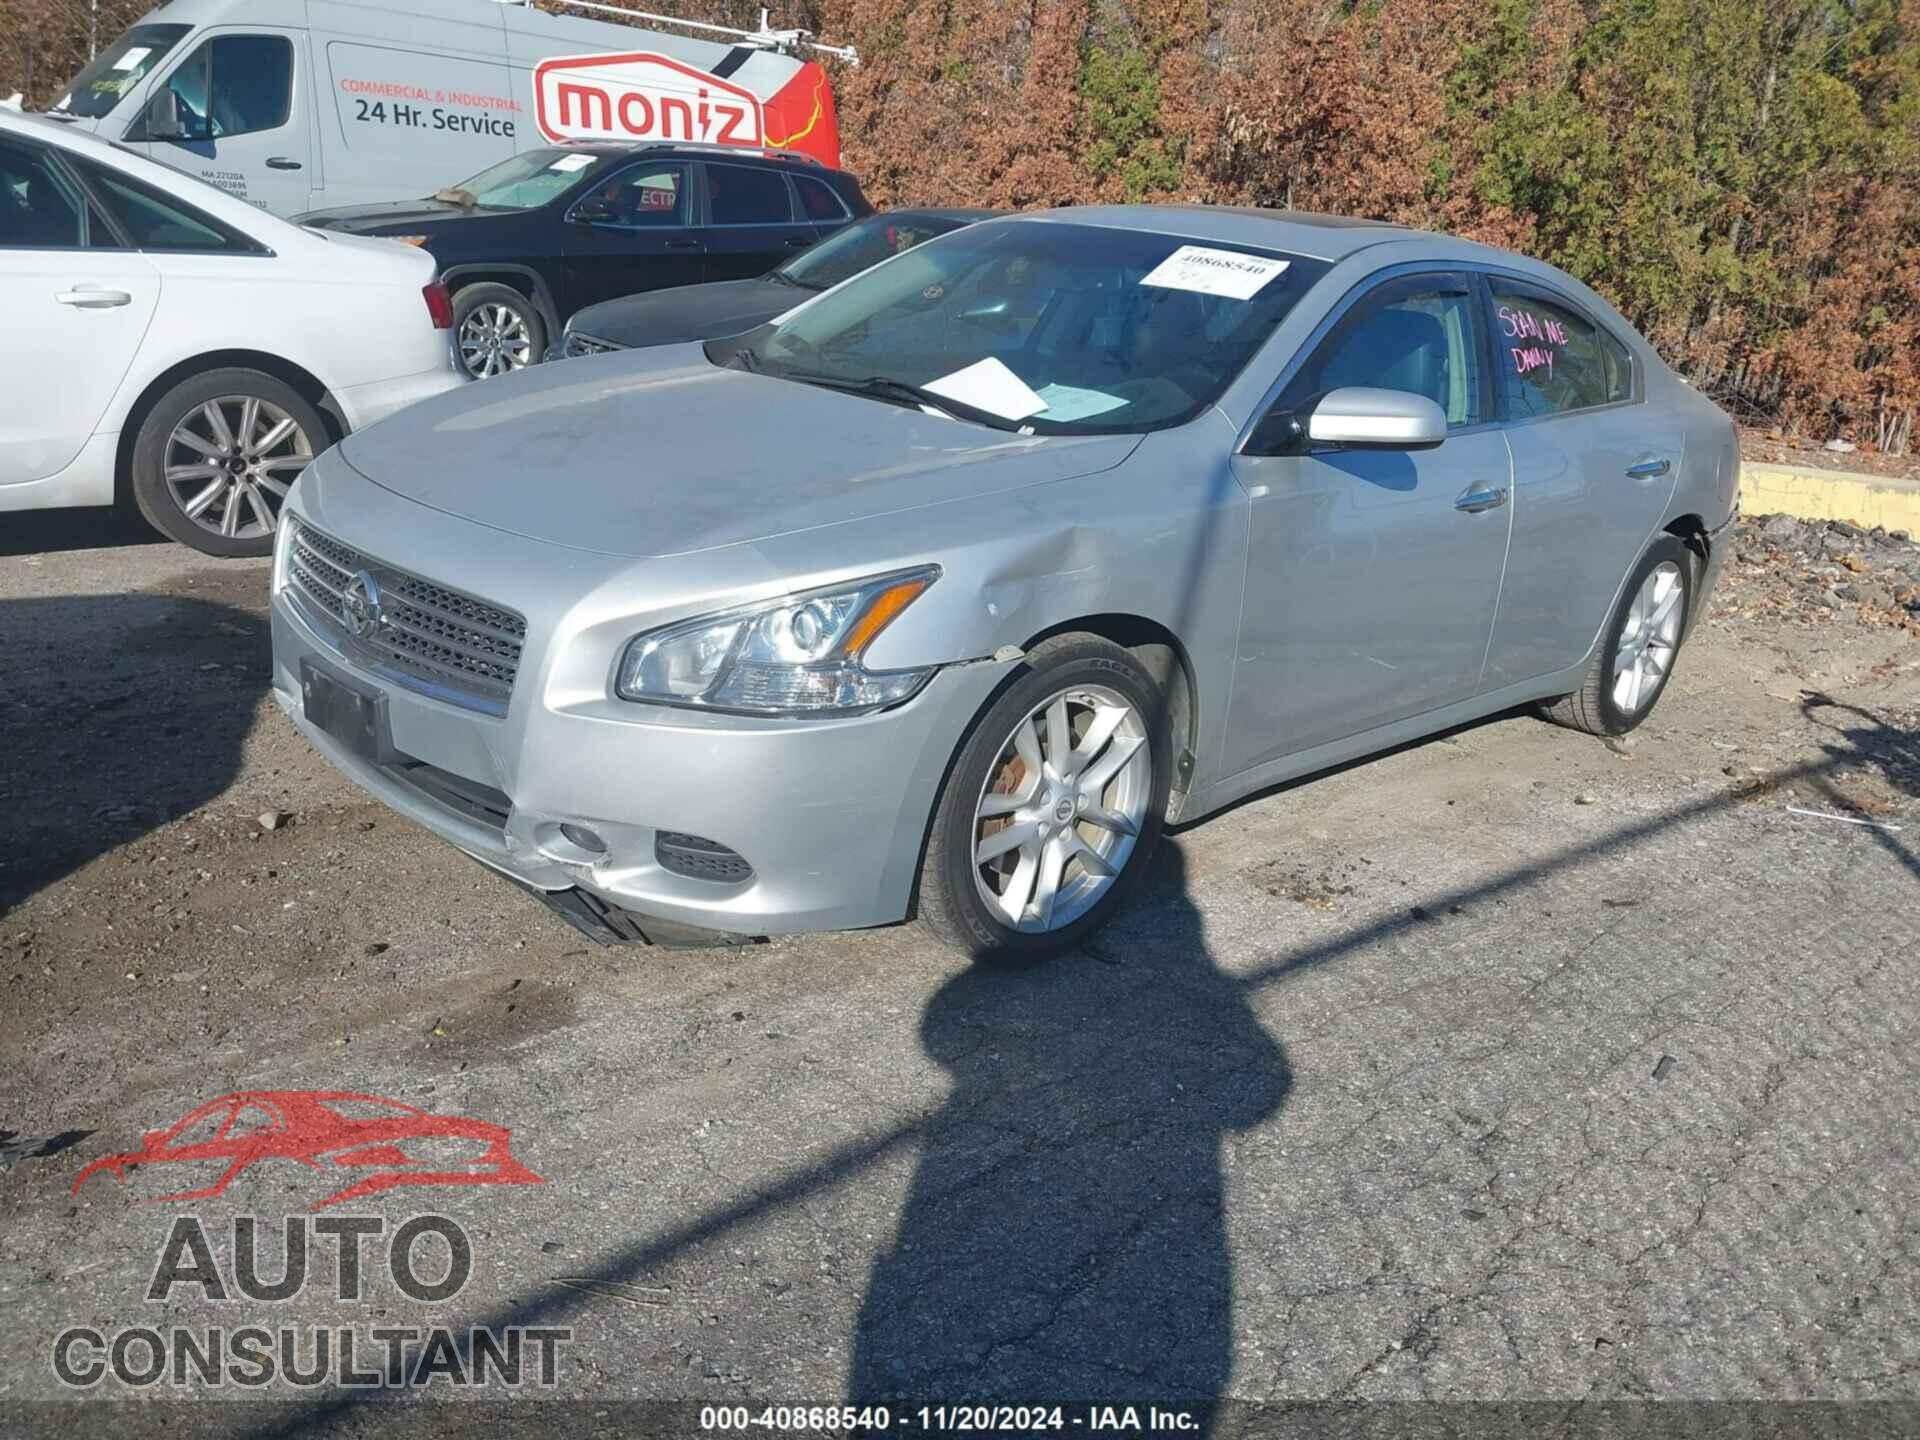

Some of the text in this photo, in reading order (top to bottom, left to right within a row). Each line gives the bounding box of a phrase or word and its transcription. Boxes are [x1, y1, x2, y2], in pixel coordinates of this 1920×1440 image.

[340, 79, 523, 113] COMMERCIAL & INDUSTRIAL
[355, 99, 515, 137] 24 Hr. Service
[557, 83, 758, 146] moniz
[1182, 254, 1267, 276] 40868540
[1544, 318, 1569, 346] ME
